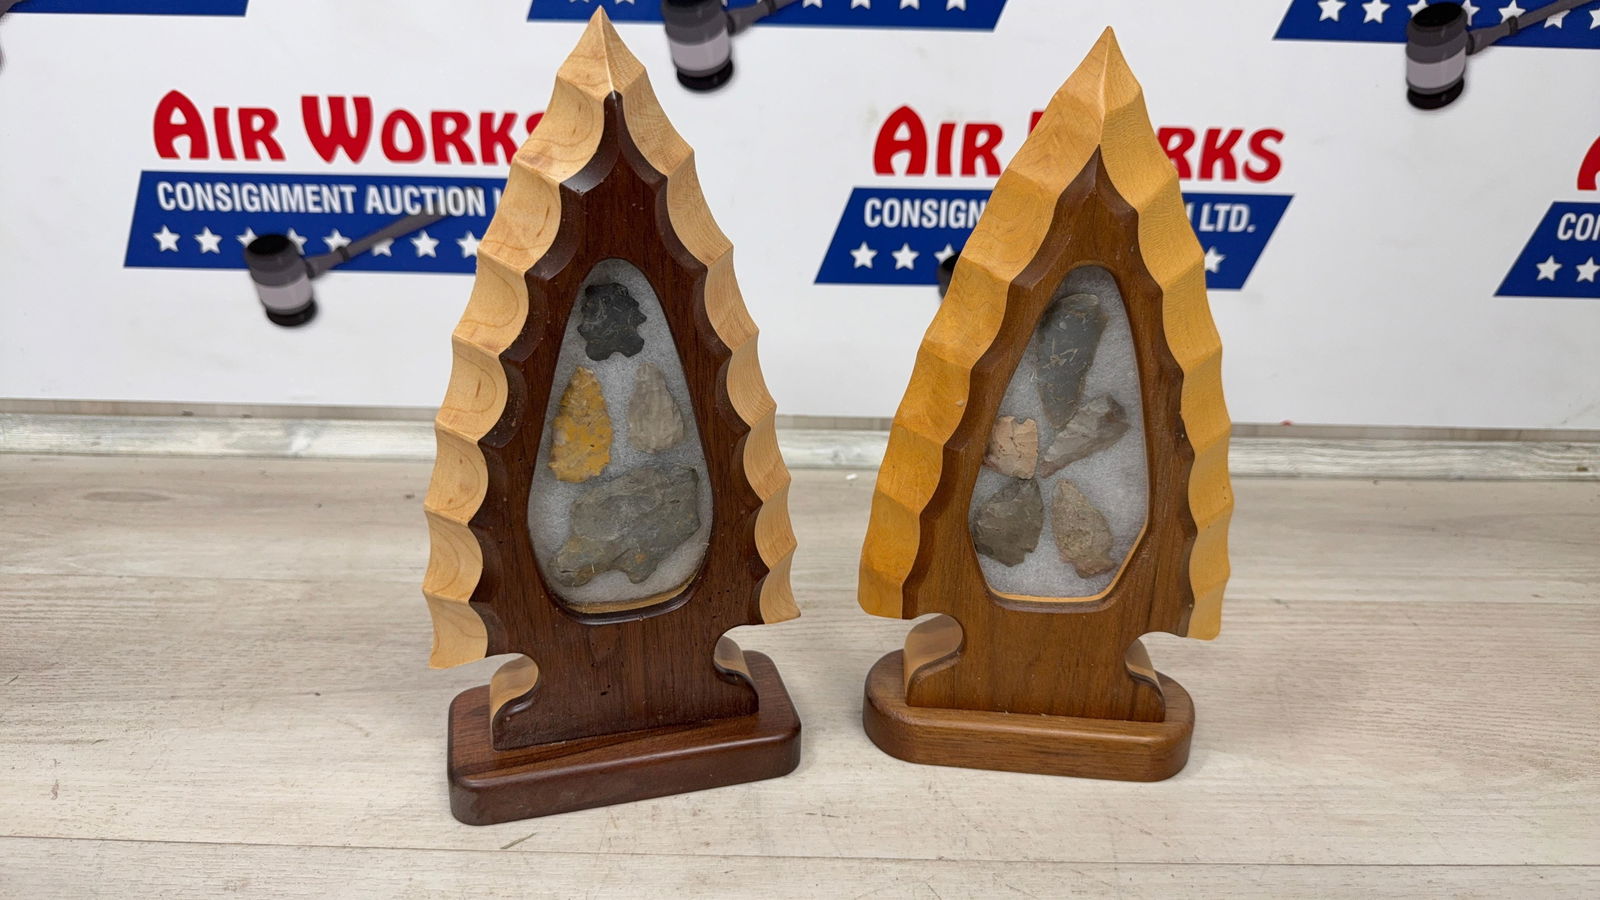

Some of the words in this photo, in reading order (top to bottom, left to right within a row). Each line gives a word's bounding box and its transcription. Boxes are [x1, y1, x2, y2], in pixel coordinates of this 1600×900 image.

[153, 90, 286, 160] AIR
[300, 95, 546, 165] WORK
[873, 105, 1003, 176] AIR
[156, 181, 357, 214] CONSIGNMENT
[365, 185, 486, 217] AUCTION
[864, 198, 988, 229] CONSIGN
[1199, 203, 1256, 233] LTD.
